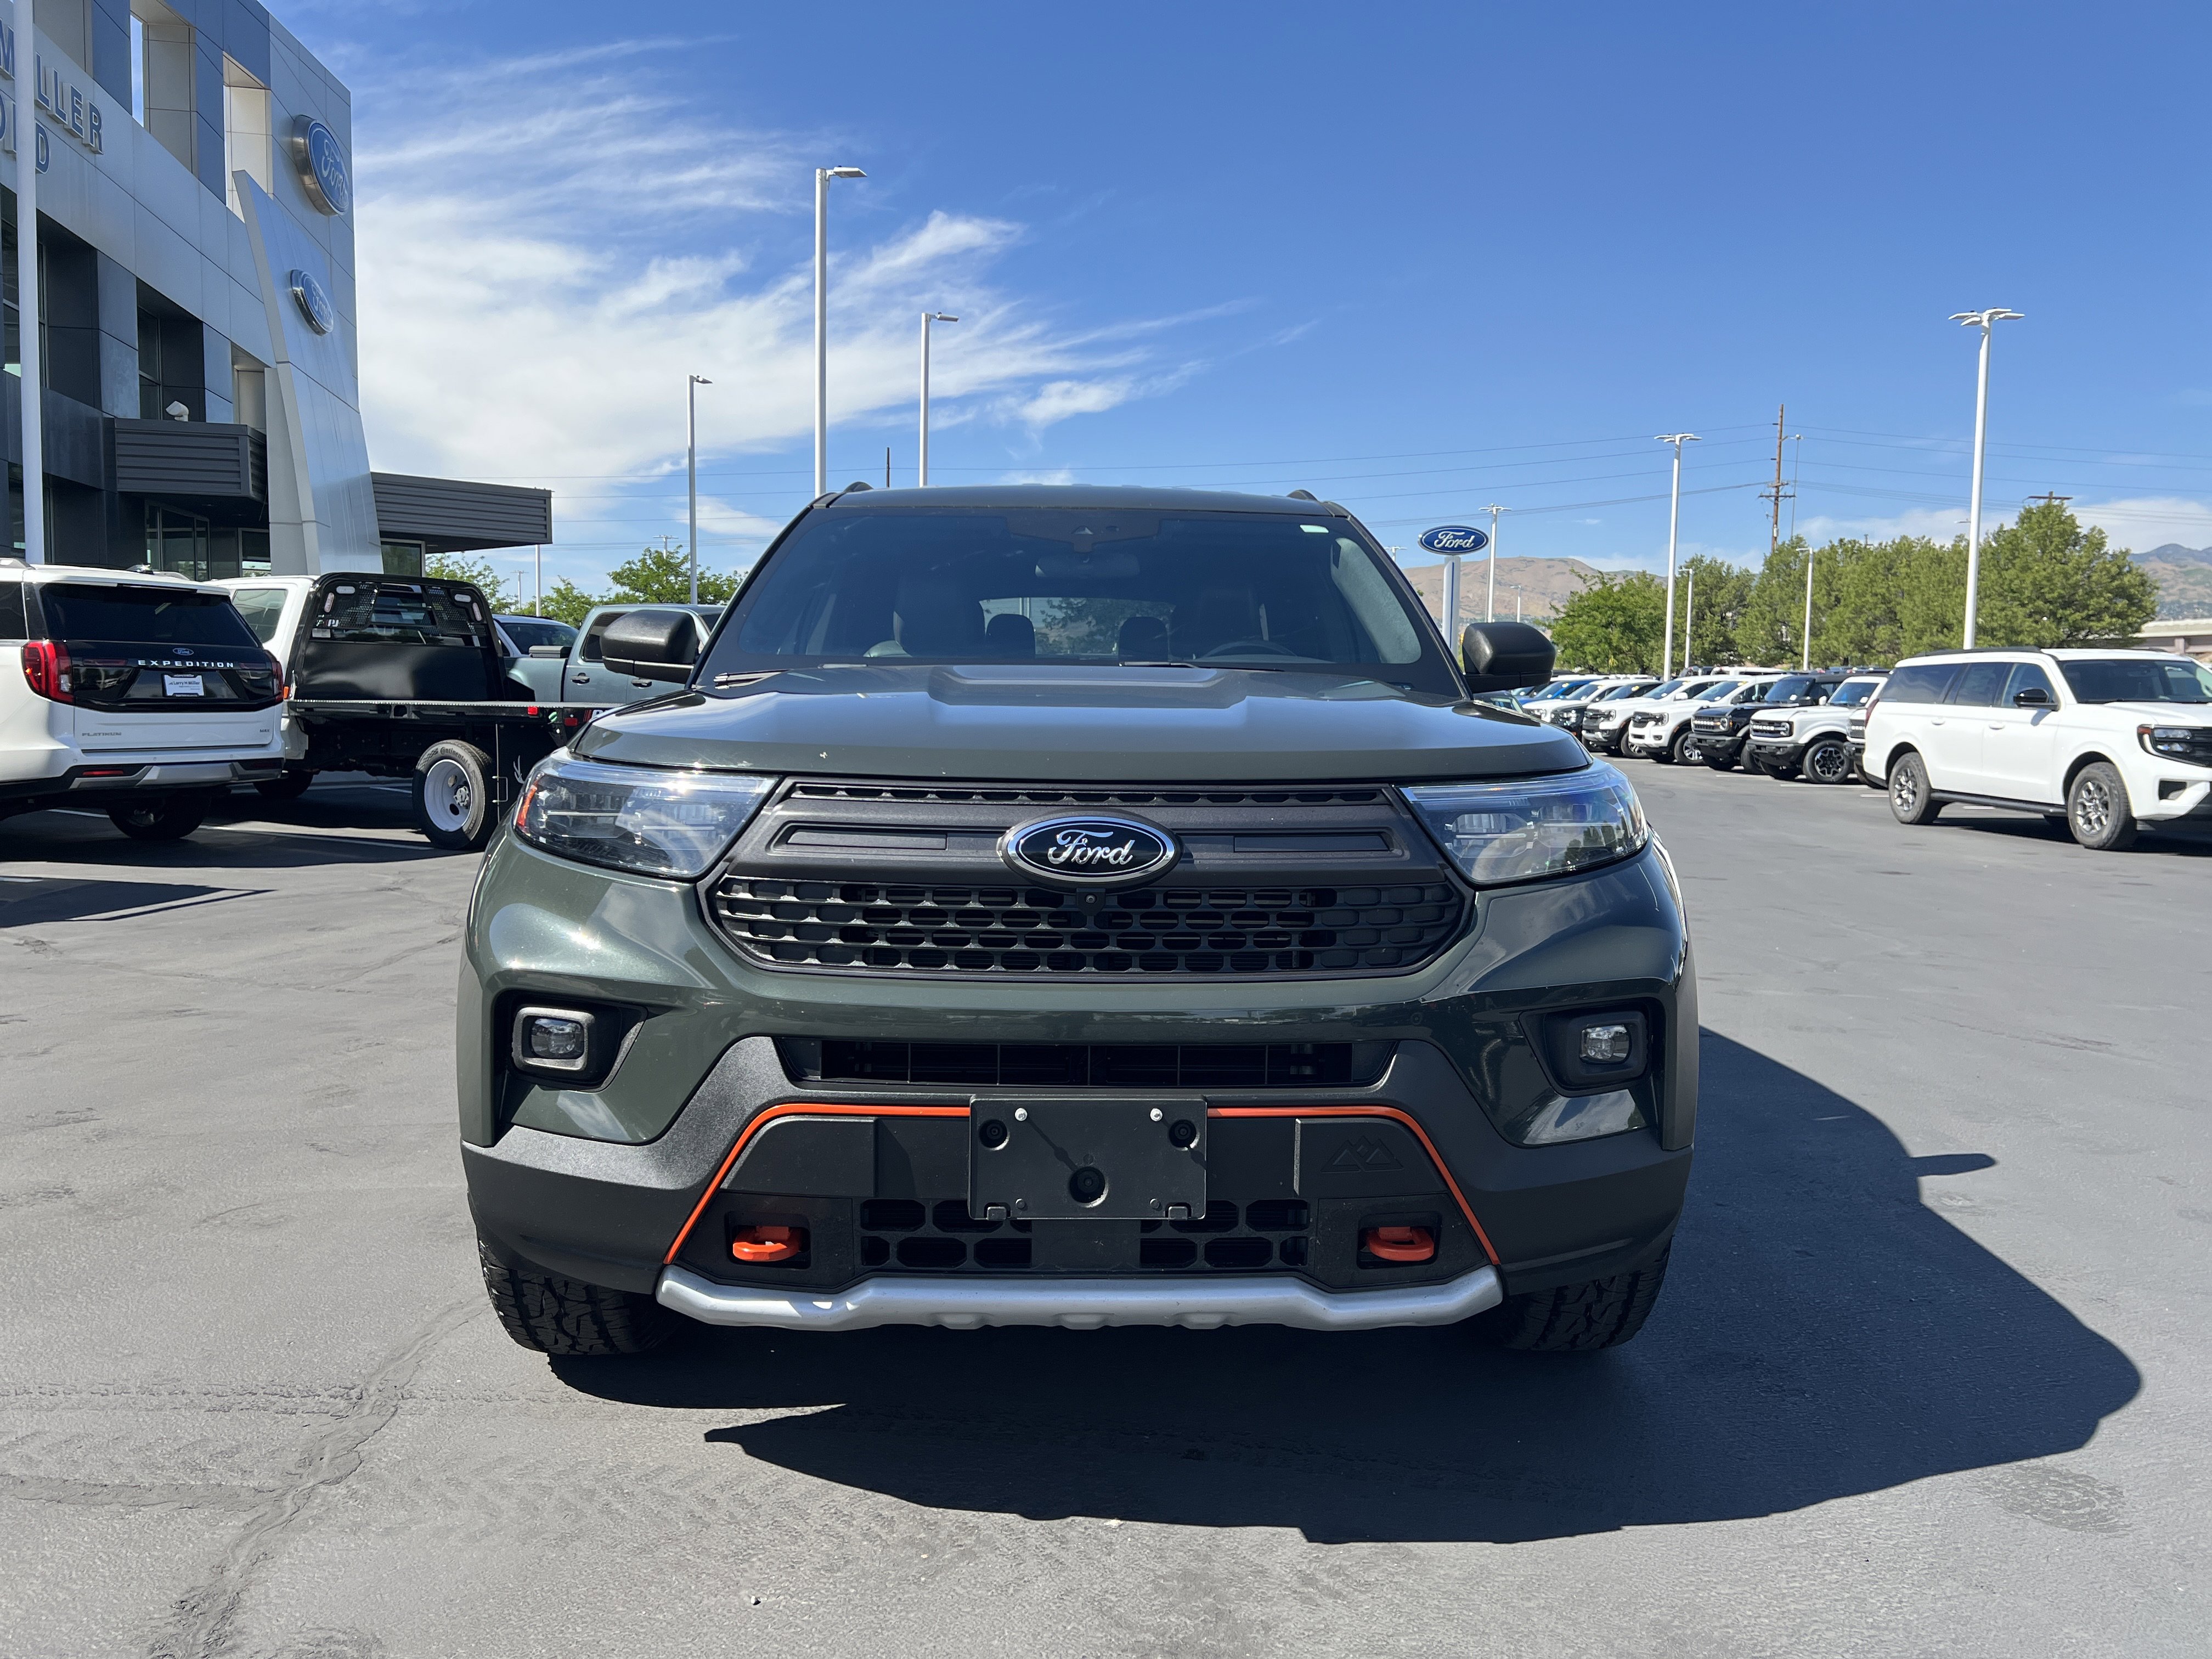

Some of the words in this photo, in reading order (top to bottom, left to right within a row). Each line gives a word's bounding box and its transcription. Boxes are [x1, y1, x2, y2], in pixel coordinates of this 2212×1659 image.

[0, 18, 103, 154] MLLER
[321, 139, 348, 203] Ford
[1434, 531, 1475, 548] Ford
[138, 659, 234, 668] EXPEDITION
[1047, 829, 1136, 866] Ford
